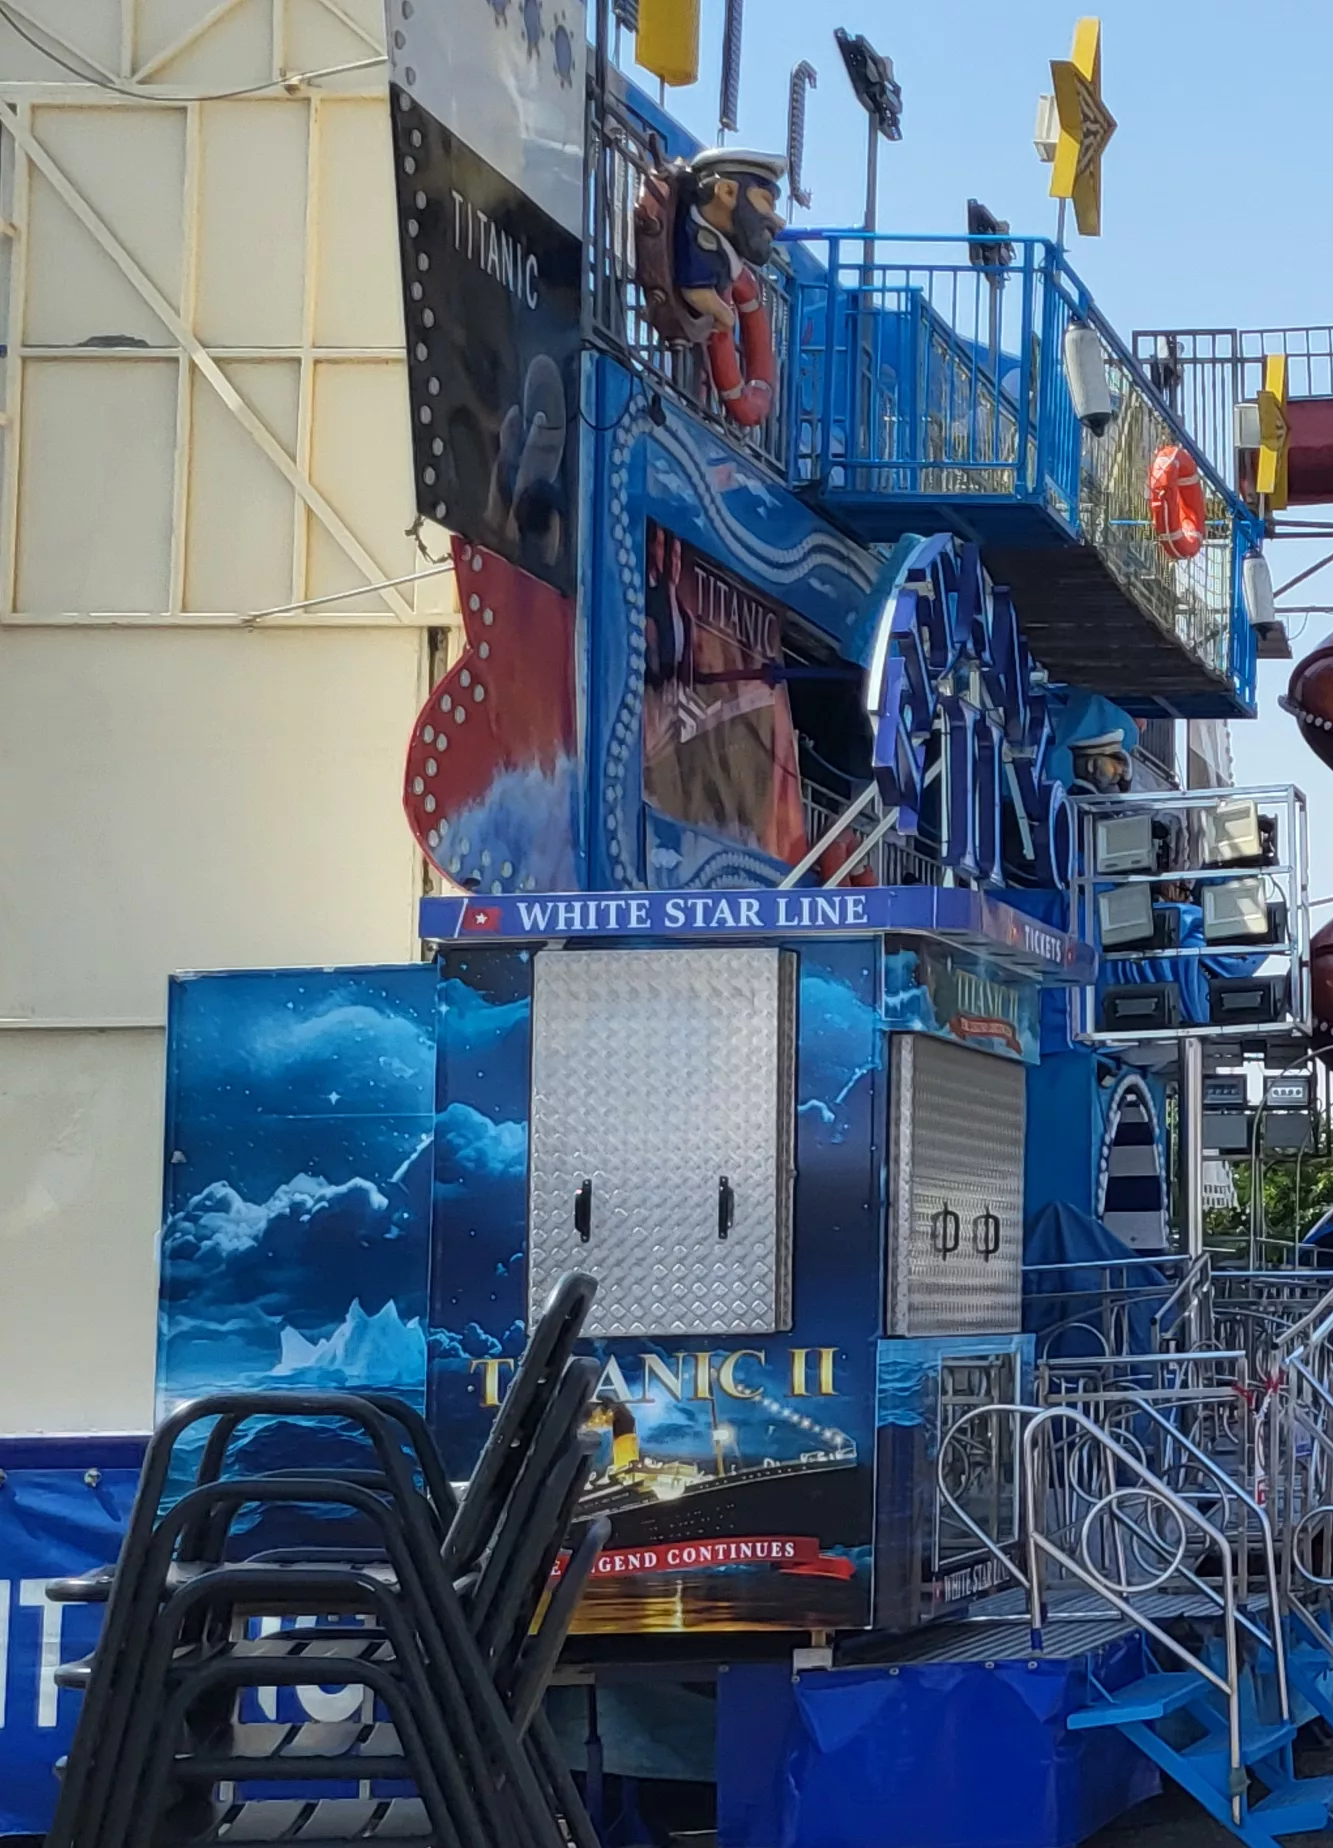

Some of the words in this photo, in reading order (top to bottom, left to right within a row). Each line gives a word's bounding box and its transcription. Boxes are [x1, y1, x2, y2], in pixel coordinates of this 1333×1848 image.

[451, 188, 538, 310] TITANIC
[693, 565, 778, 659] TITANIC
[517, 901, 651, 931] WHITE
[664, 898, 764, 928] STAR
[775, 895, 868, 926] LINE
[1024, 925, 1062, 963] TICKETS
[467, 1347, 766, 1410] TANIC
[788, 1347, 839, 1397] II
[591, 1551, 657, 1574] GEND
[667, 1541, 796, 1567] CONTINUES
